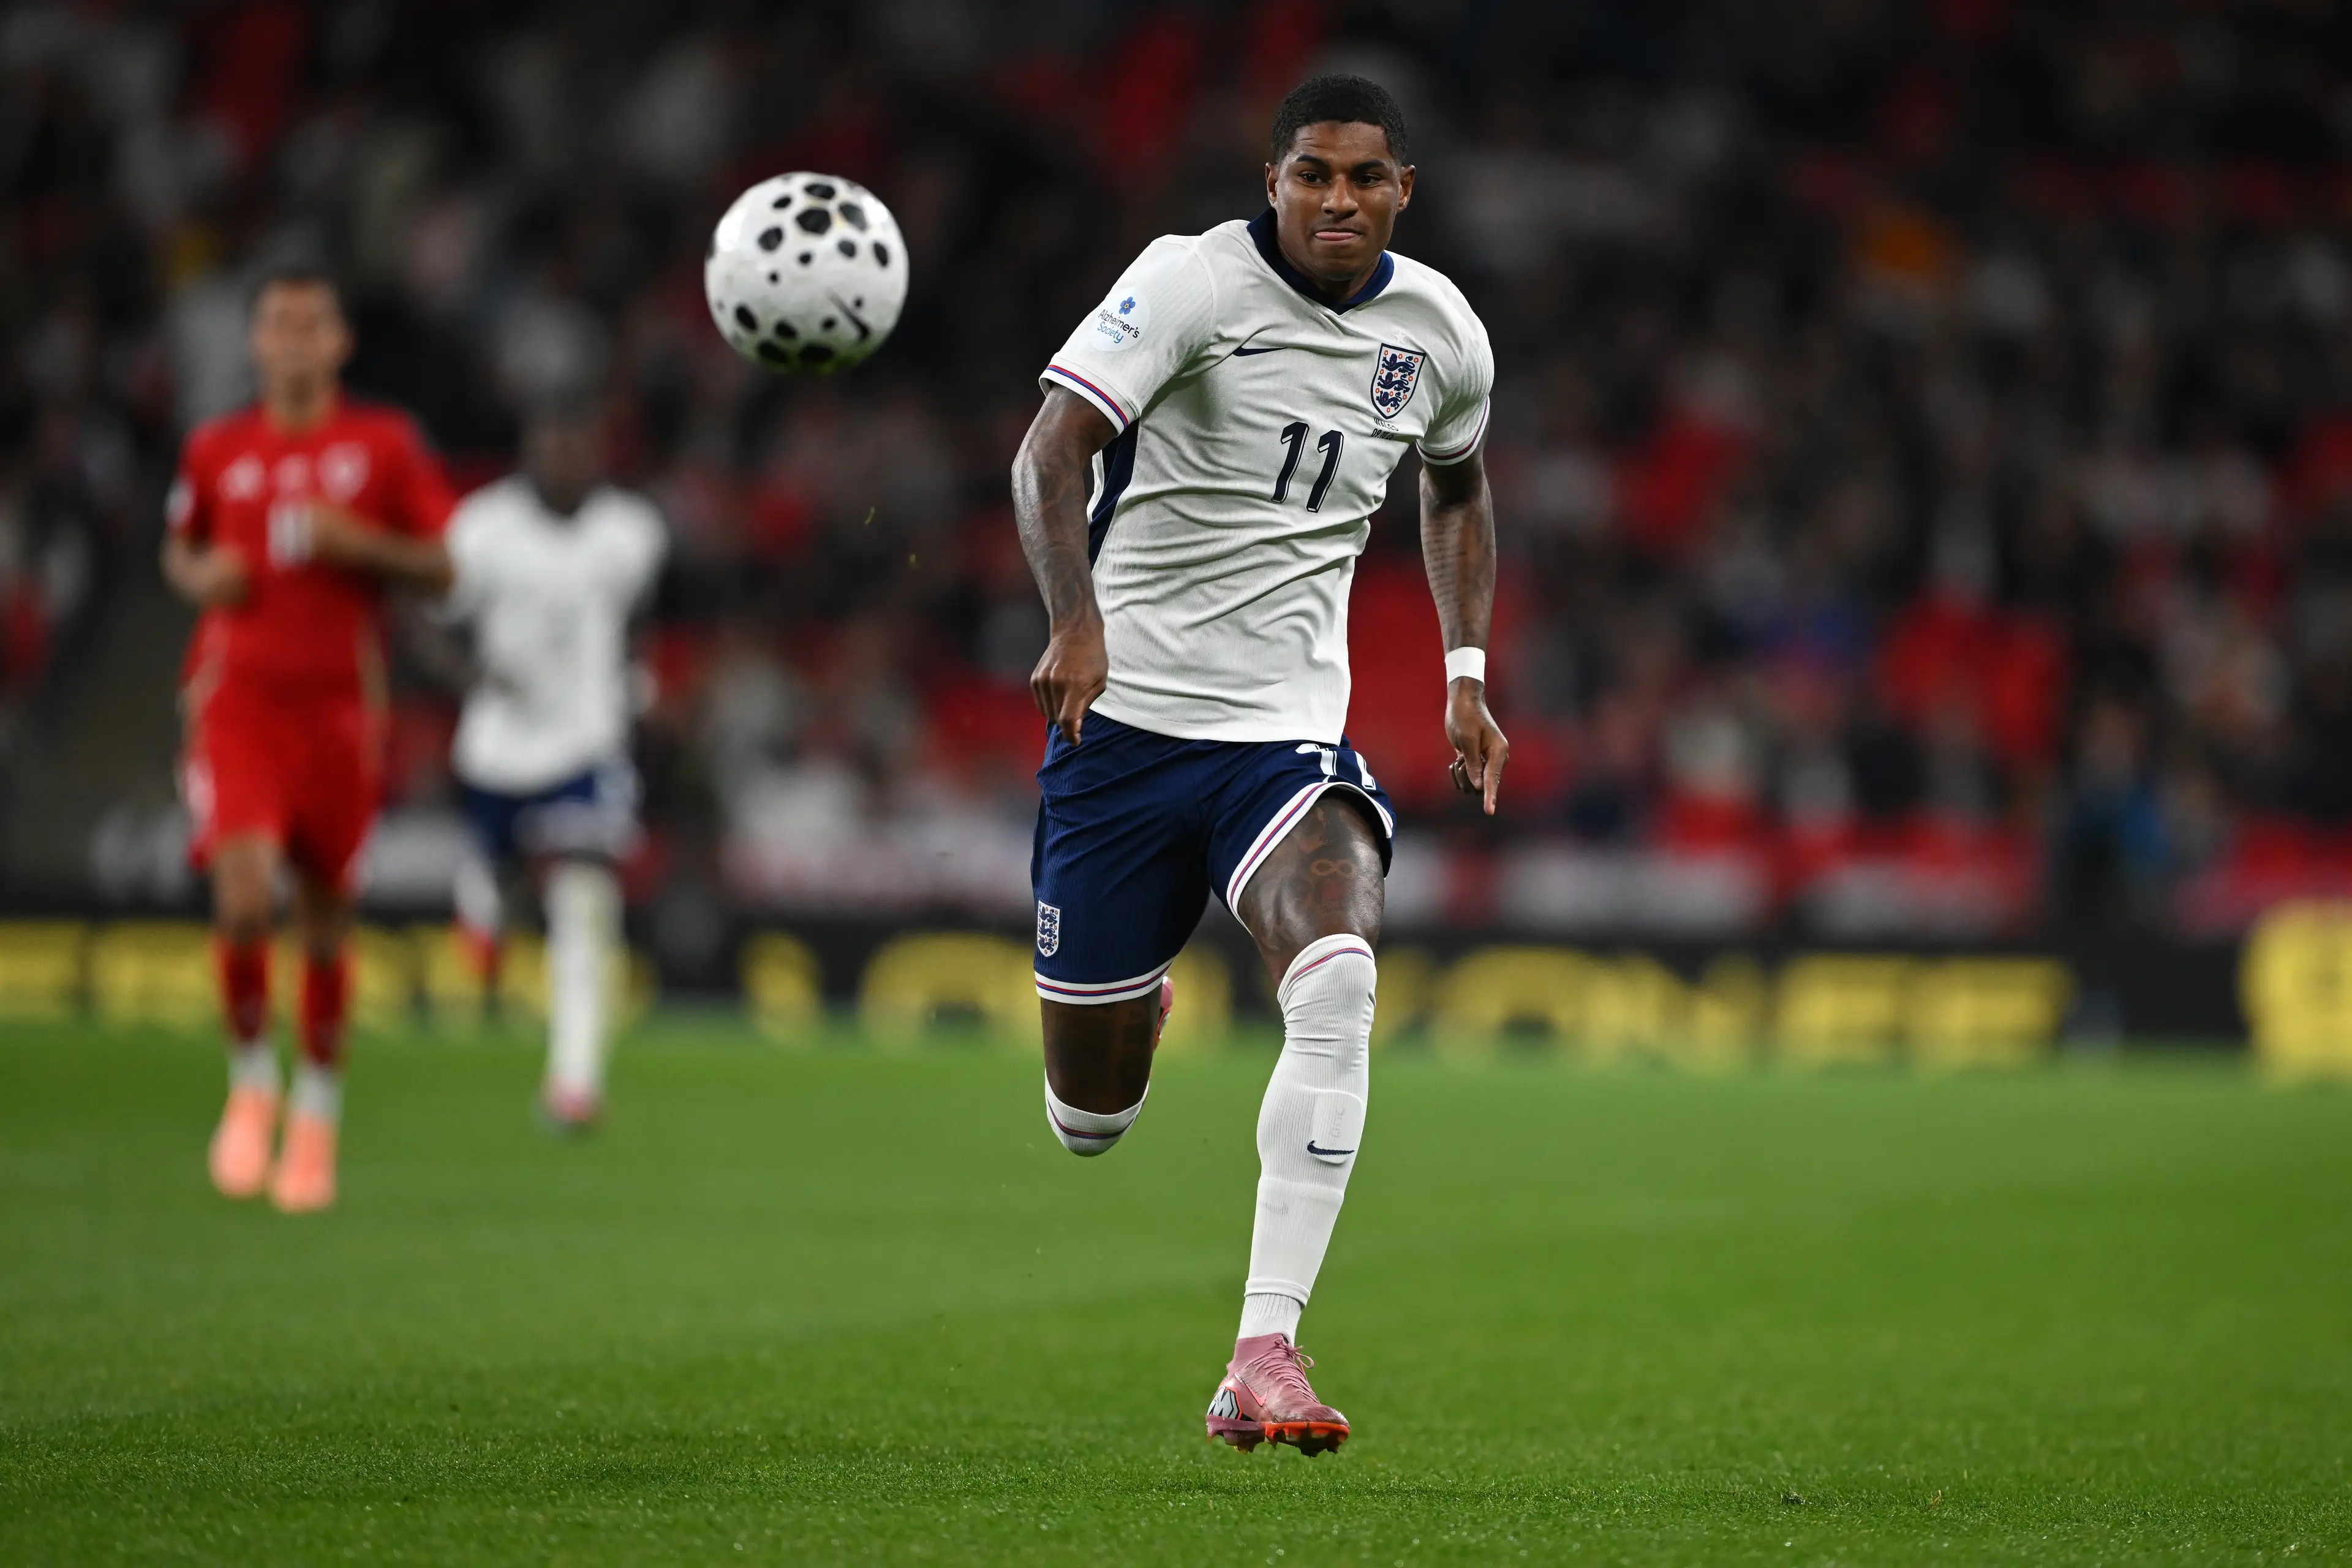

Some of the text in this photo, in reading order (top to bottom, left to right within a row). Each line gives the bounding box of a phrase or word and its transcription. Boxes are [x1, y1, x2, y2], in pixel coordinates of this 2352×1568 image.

[1097, 321, 1125, 344] Society
[1098, 309, 1140, 339] Alzheimer's
[1270, 421, 1344, 513] 11
